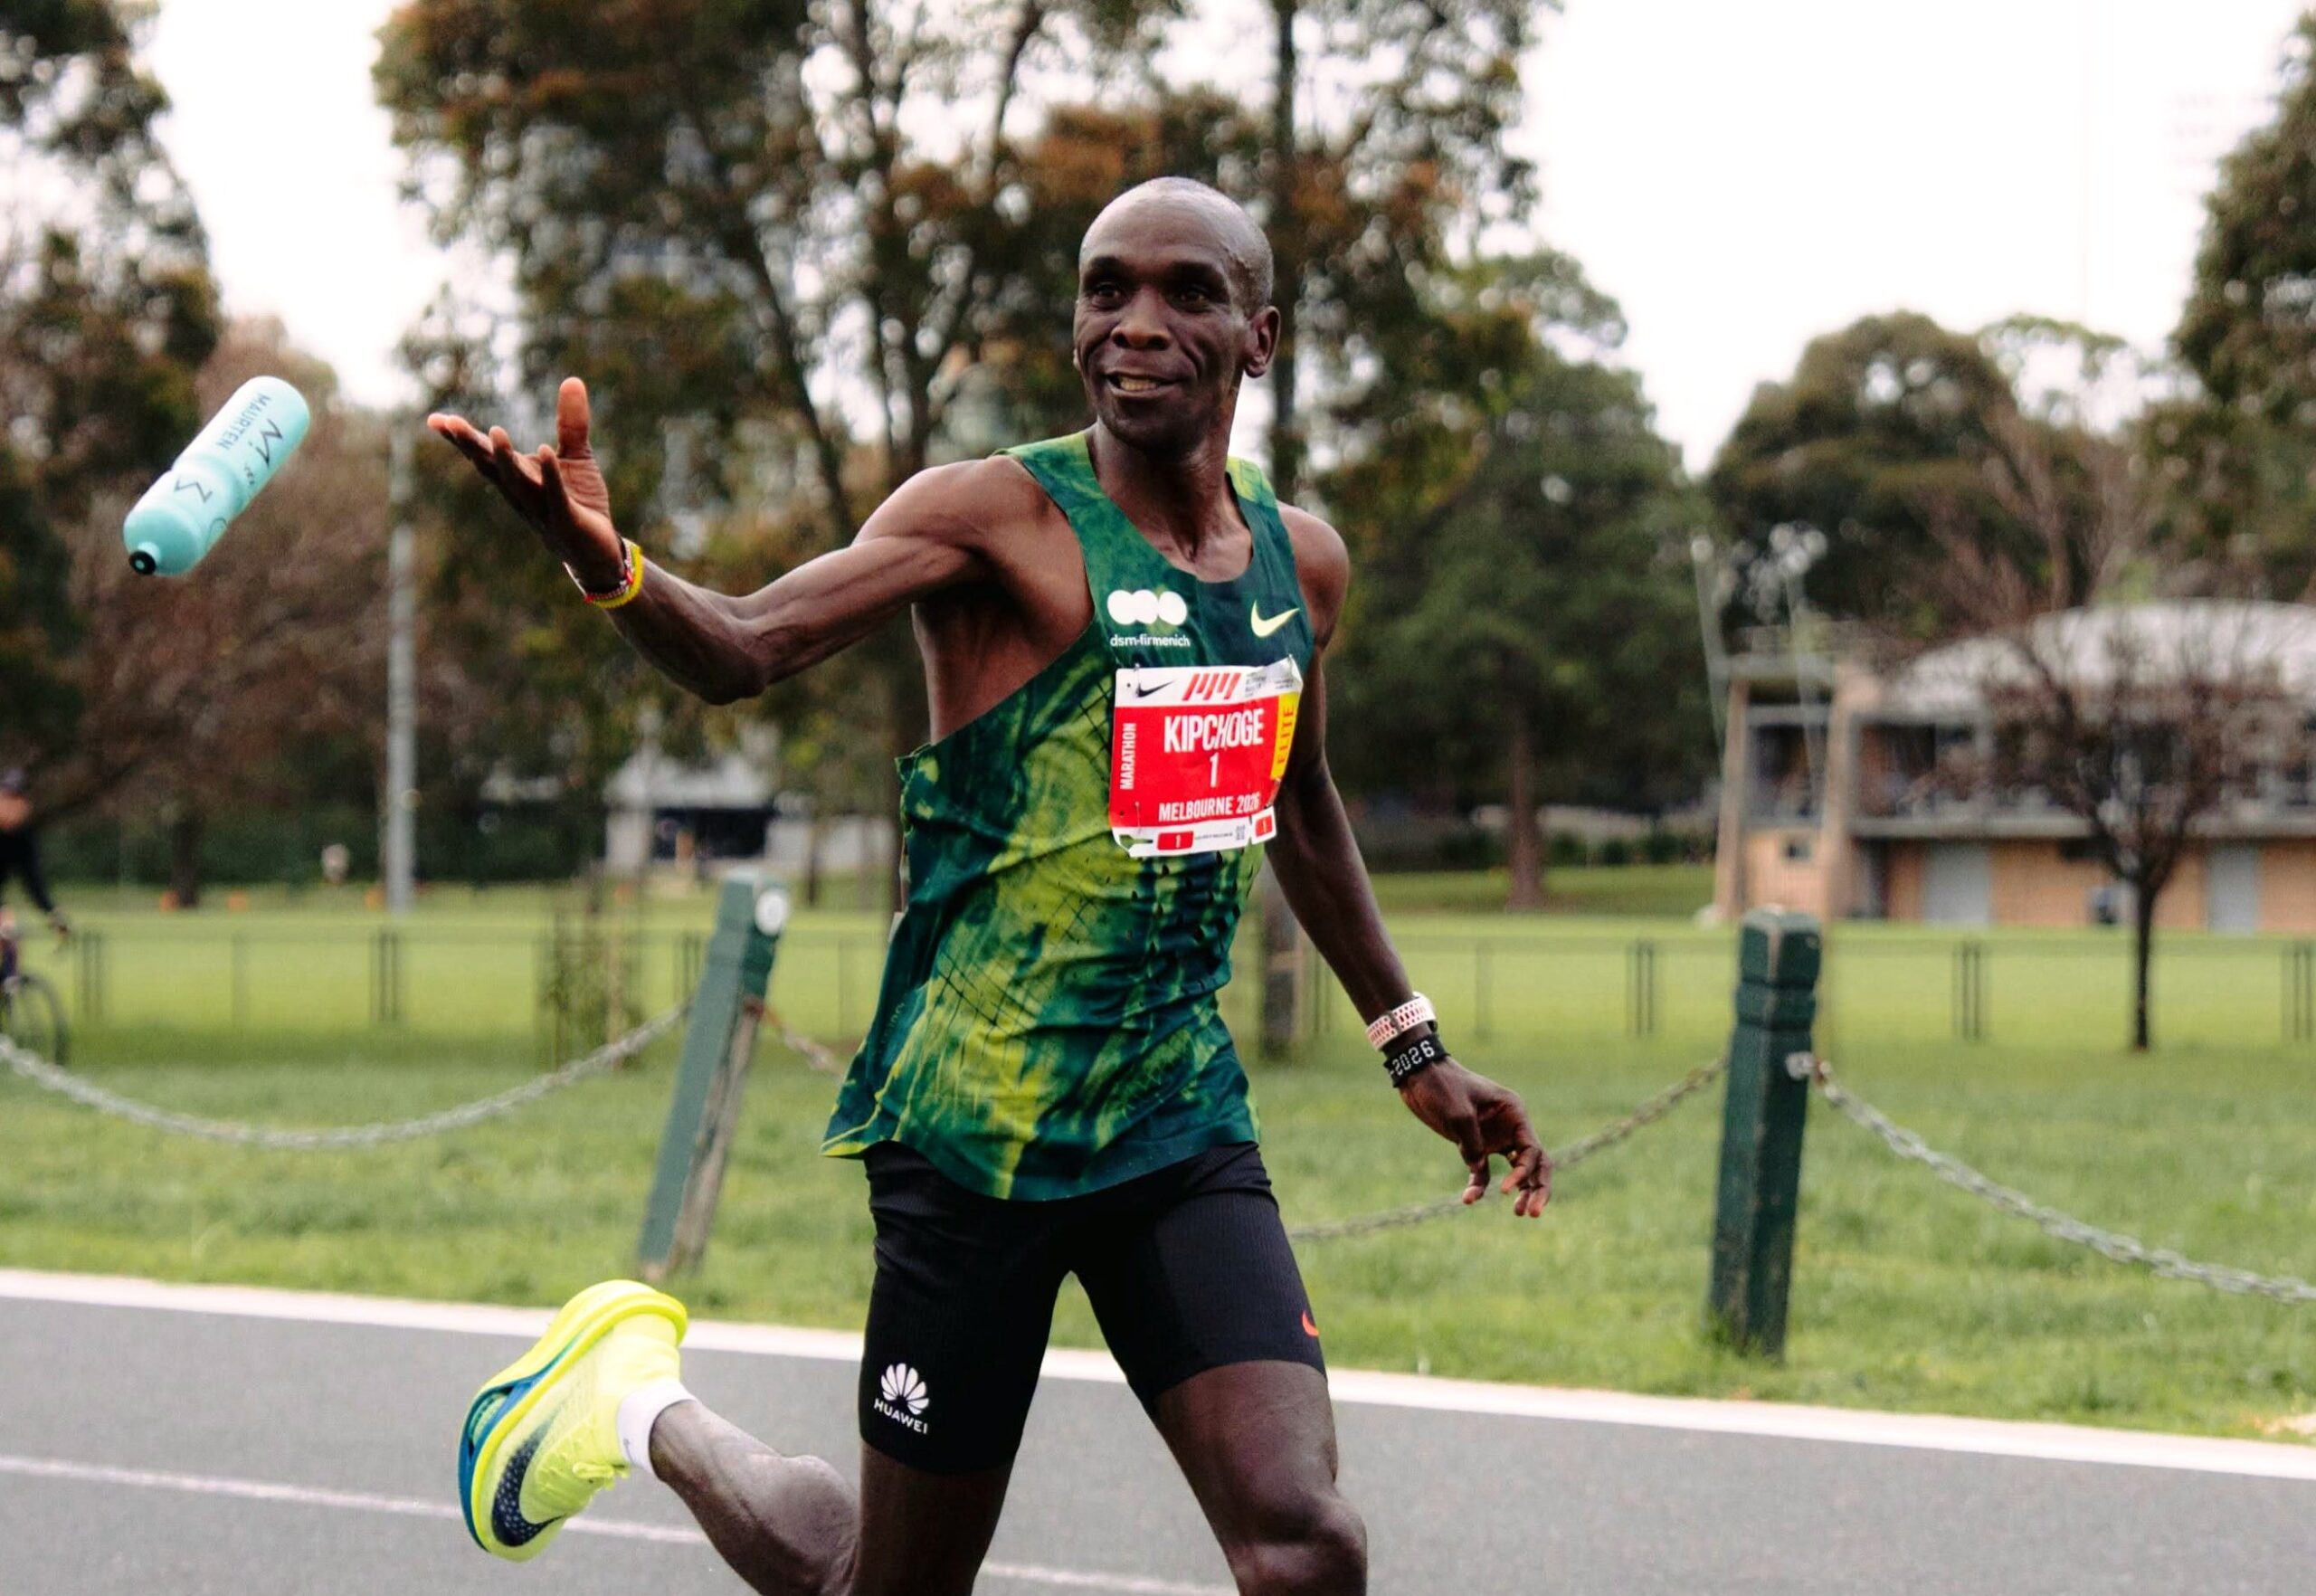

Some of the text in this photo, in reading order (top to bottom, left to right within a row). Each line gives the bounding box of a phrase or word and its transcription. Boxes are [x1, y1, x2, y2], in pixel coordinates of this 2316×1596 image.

[216, 393, 271, 451] MAURTEN
[1109, 633, 1191, 648] dsm-firmenich
[1163, 708, 1265, 753] KIPCHOGE
[1277, 704, 1294, 765] ELITE
[1119, 722, 1137, 791] MARATHON
[1209, 752, 1220, 788] 1
[1158, 795, 1235, 822] MELBOURNE
[1261, 818, 1268, 833] 1
[1175, 833, 1182, 850] 1
[873, 1397, 928, 1435] HUAWEI
